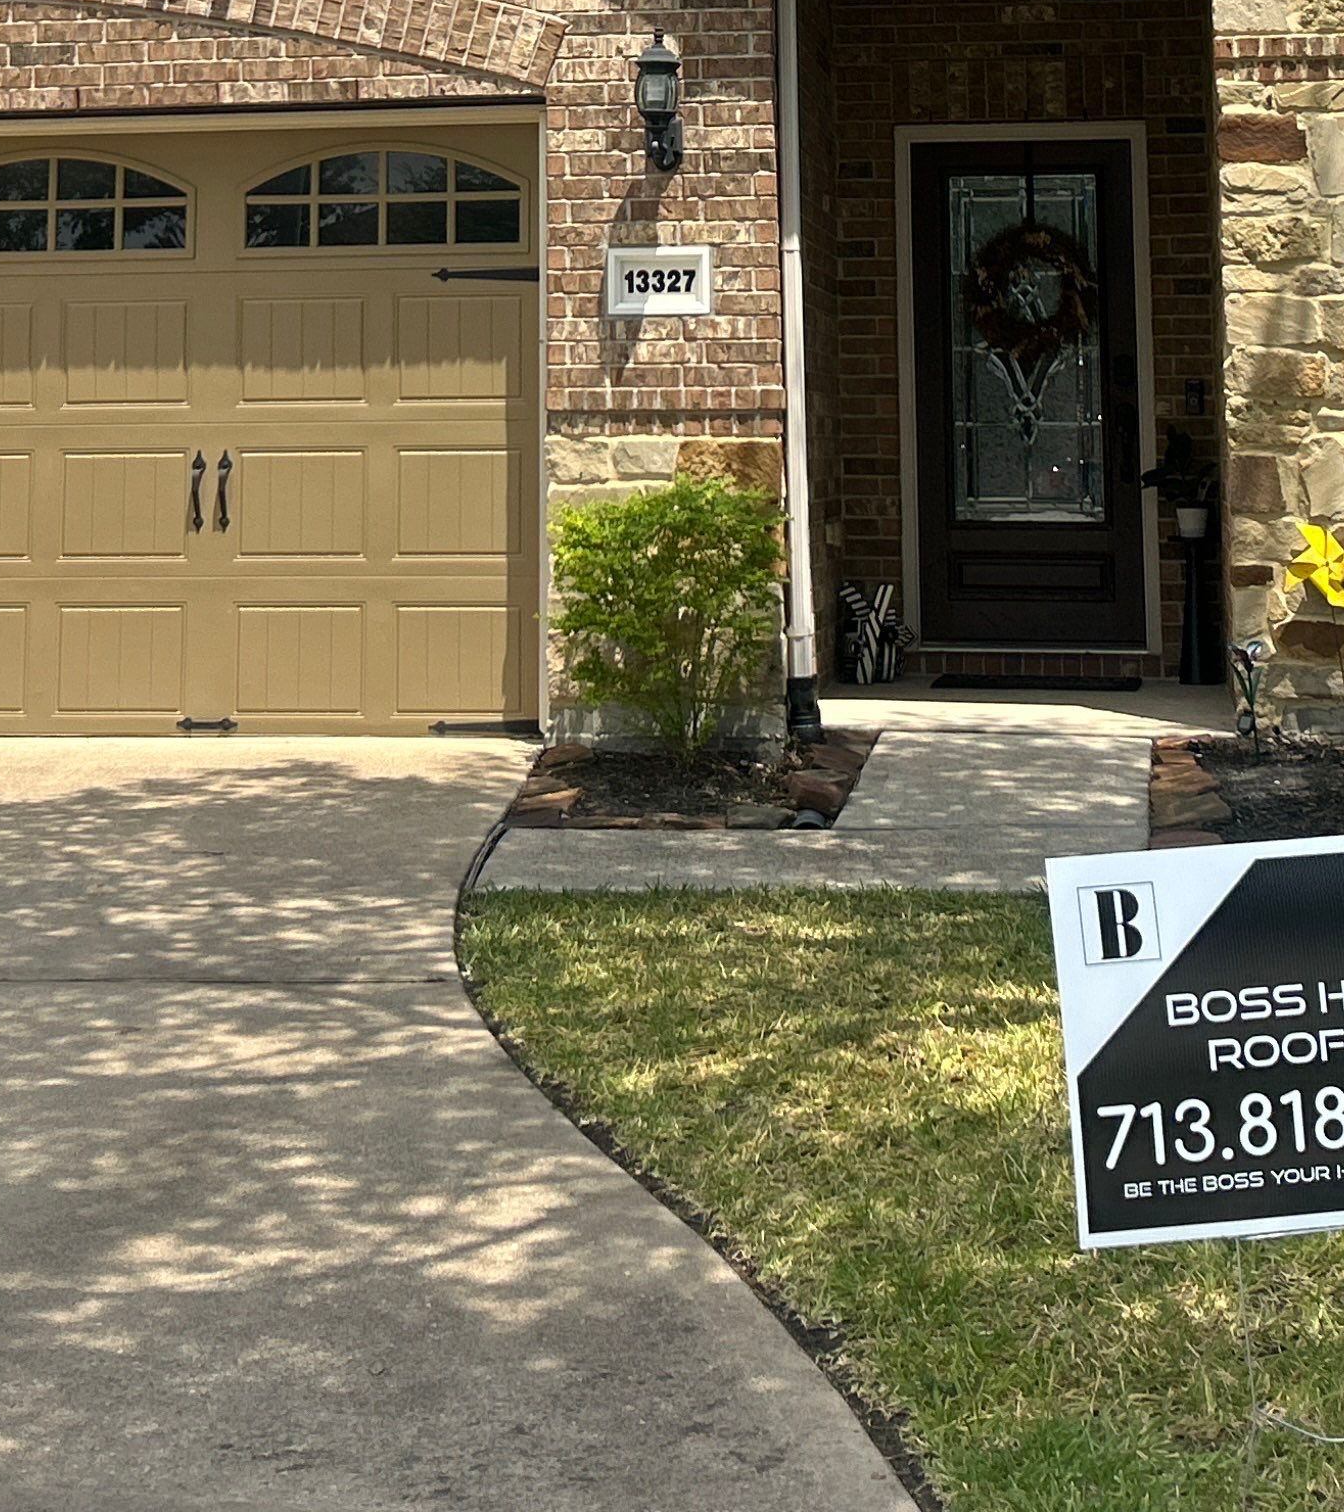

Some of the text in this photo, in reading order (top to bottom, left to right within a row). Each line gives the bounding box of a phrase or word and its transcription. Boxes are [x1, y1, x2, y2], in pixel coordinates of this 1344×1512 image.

[624, 269, 696, 294] 13327
[1093, 888, 1143, 960] B
[1165, 983, 1307, 1027] BOSS
[1123, 1181, 1153, 1199] BE
[1157, 1178, 1198, 1195] THE
[1202, 1170, 1265, 1193] BOSS
[1270, 1165, 1331, 1185] YOUR
